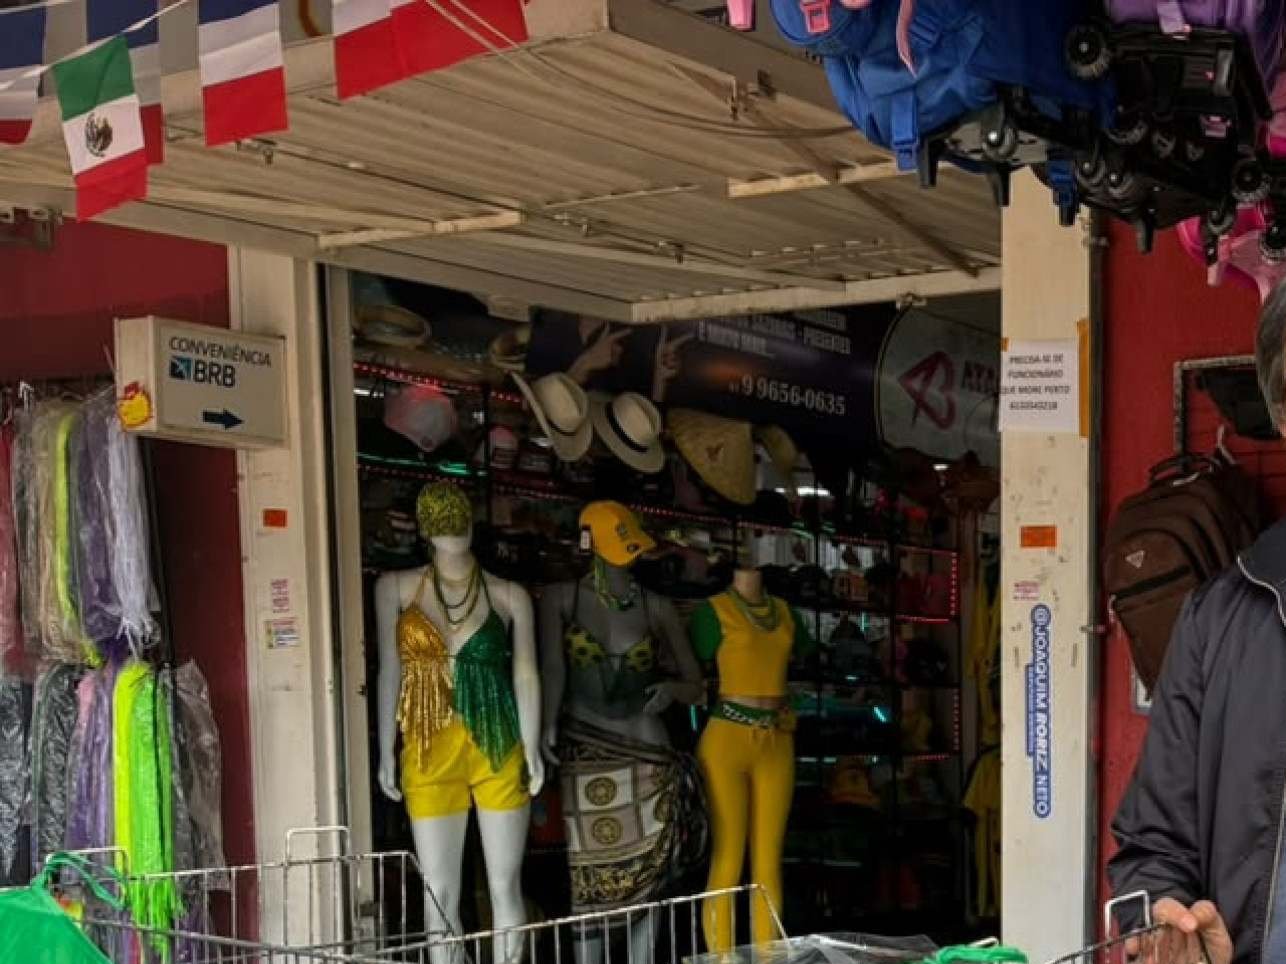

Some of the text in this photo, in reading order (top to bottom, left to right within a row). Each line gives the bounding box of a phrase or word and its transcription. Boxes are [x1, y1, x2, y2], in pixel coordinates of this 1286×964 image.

[169, 335, 272, 368] CONVENIÊNCIA
[194, 359, 236, 388] BRB
[1035, 711, 1048, 771] RORIZ
